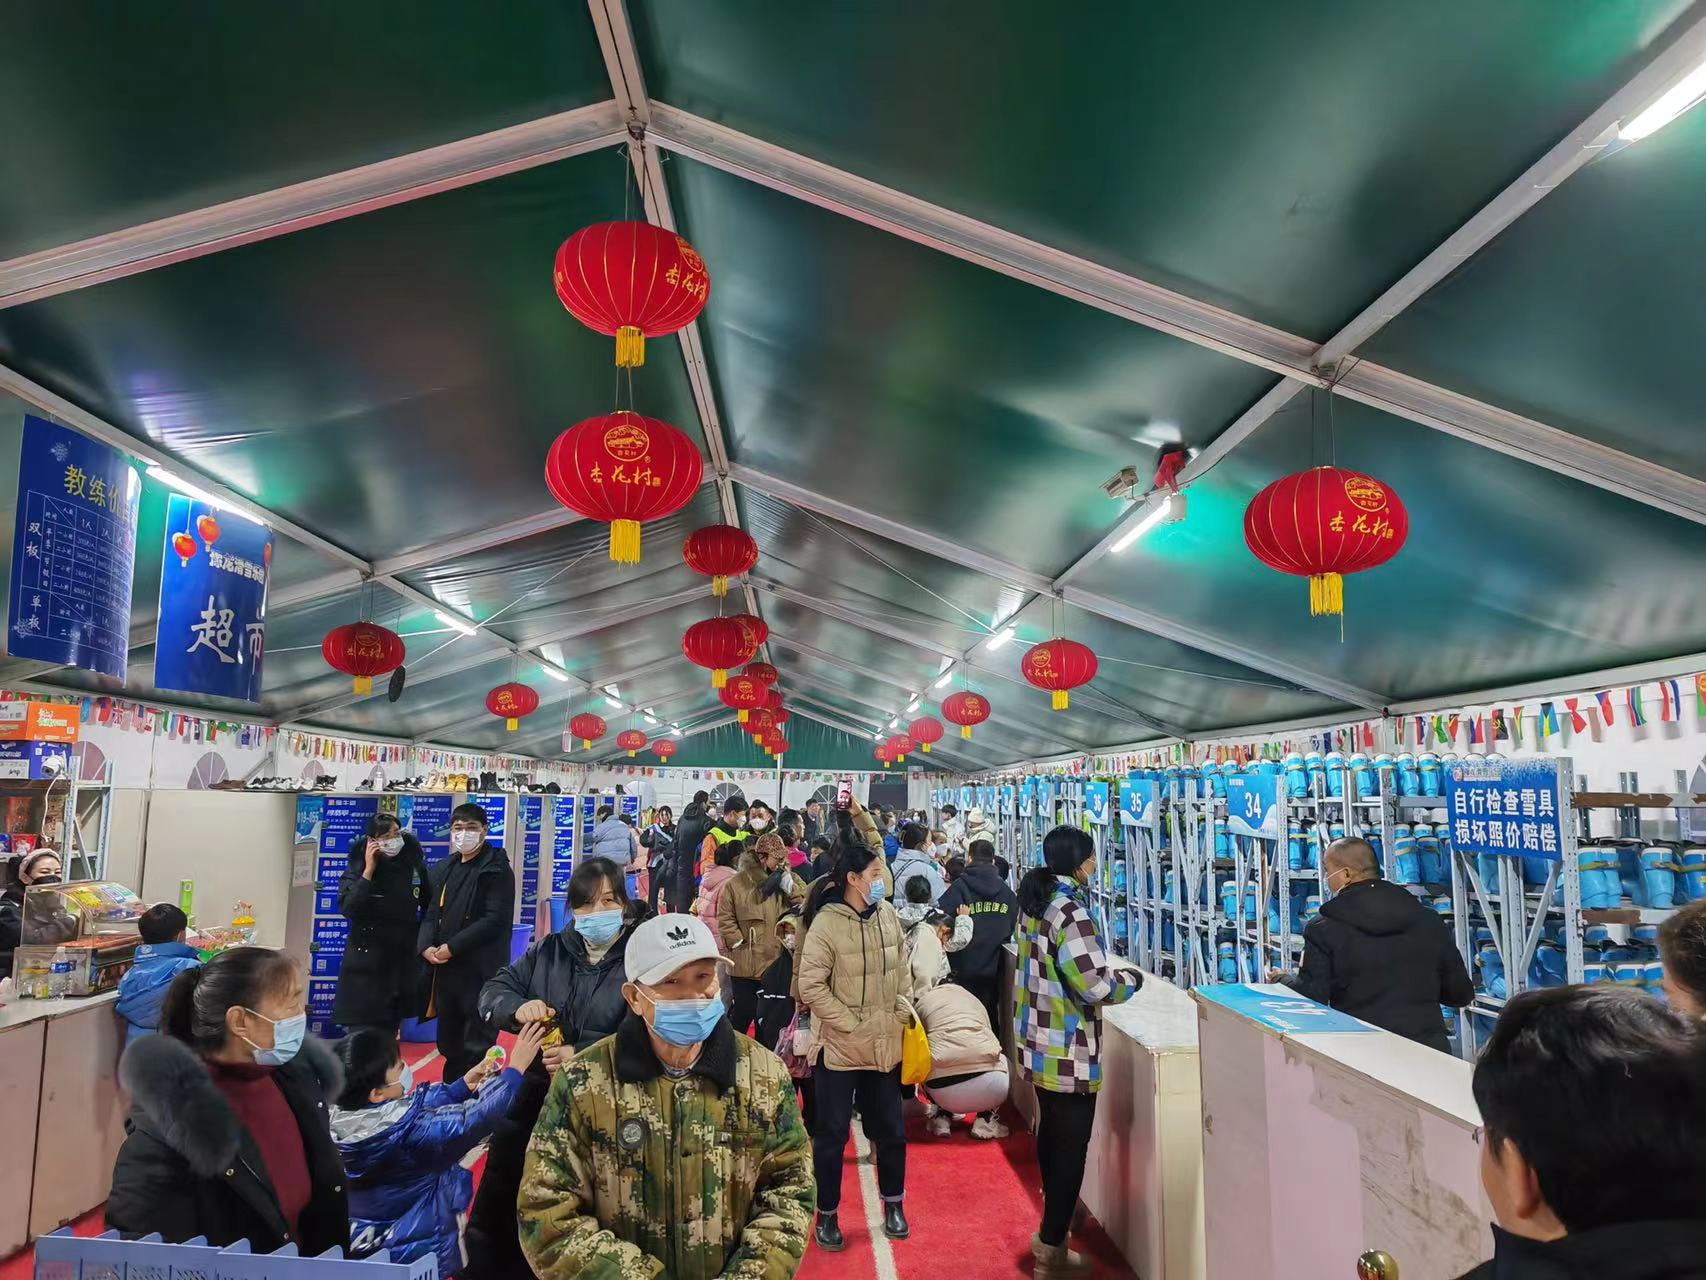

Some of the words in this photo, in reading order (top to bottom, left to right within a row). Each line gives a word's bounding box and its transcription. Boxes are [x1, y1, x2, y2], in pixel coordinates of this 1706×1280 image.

[590, 460, 652, 487] 杏花村
[1330, 510, 1390, 538] 杏花村
[1131, 792, 1142, 812] 35
[1245, 792, 1262, 819] 34
[1454, 788, 1555, 818] 自行检查雪具
[1455, 818, 1557, 853] 损坏照价赔偿
[669, 940, 697, 950] adidas
